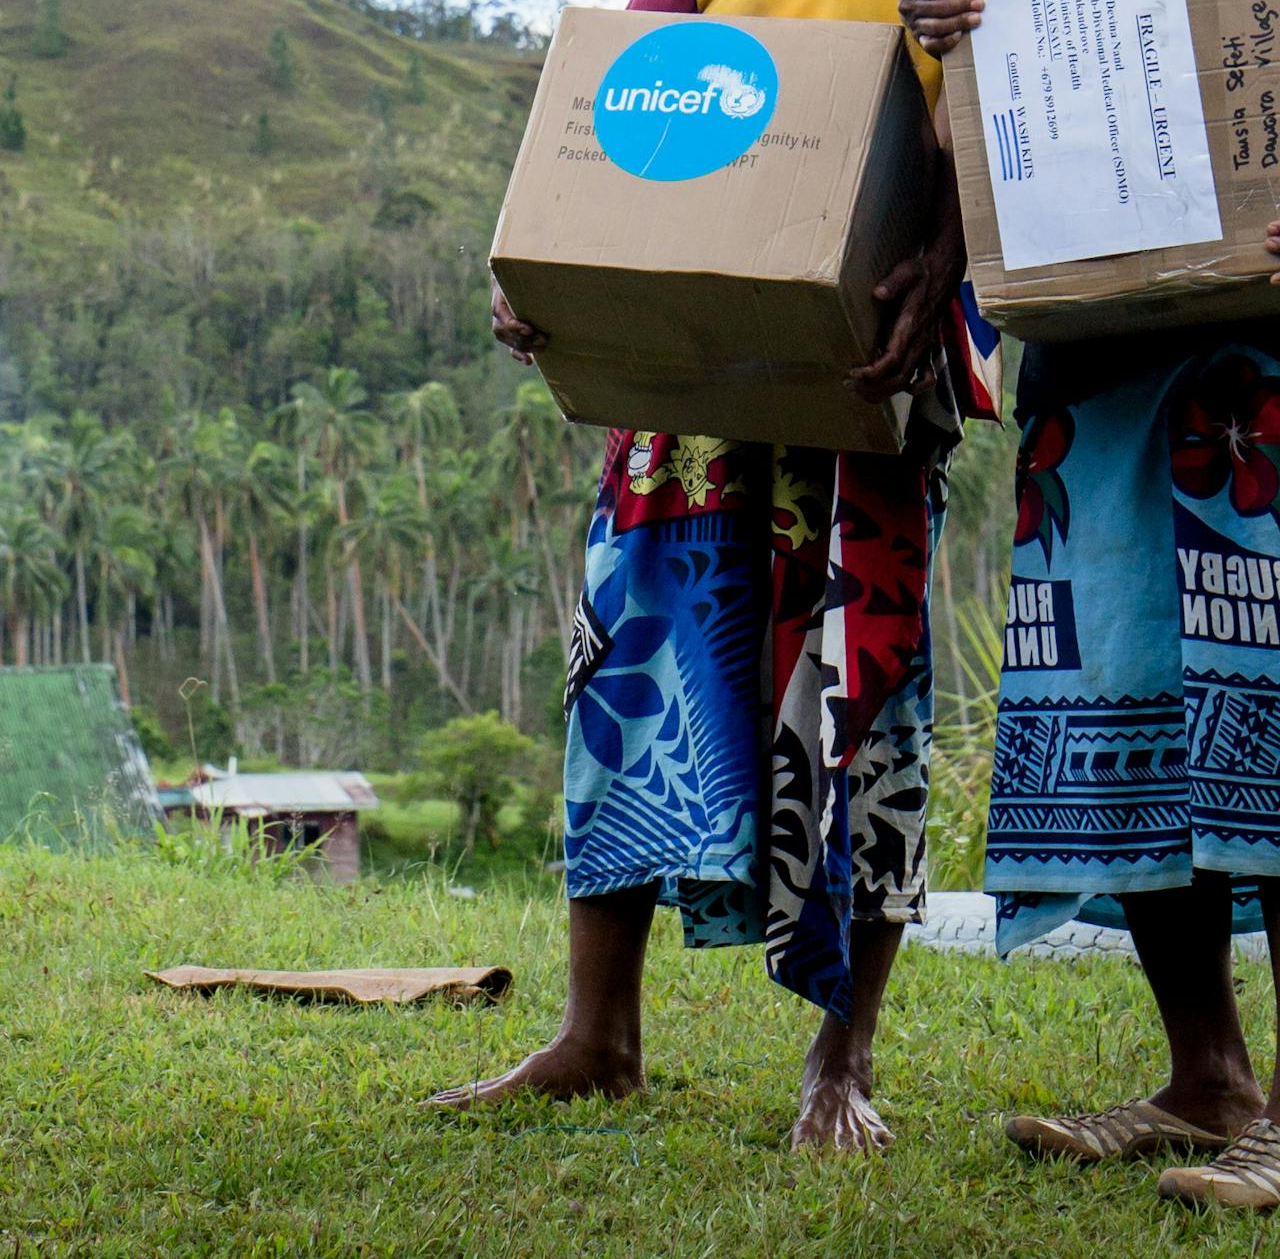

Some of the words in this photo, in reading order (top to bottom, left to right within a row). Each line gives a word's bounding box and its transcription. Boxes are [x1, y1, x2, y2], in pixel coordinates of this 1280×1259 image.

[1066, 40, 1077, 51] of
[1106, 1, 1118, 37] Devina
[1113, 42, 1124, 71] Nand
[1009, 53, 1022, 100] Content:
[1041, 66, 1053, 92] +679
[1068, 53, 1082, 90] Health
[1101, 68, 1116, 111] Medical
[604, 80, 717, 115] unicef
[1139, 14, 1162, 89] FRAGILE
[1154, 107, 1176, 178] URGENT
[1016, 106, 1030, 144] WASH
[1045, 95, 1059, 140] 8912699
[1108, 114, 1120, 153] Officer
[802, 134, 821, 150] kit
[1022, 148, 1034, 179] KITS
[1112, 156, 1129, 204] (SDMO)
